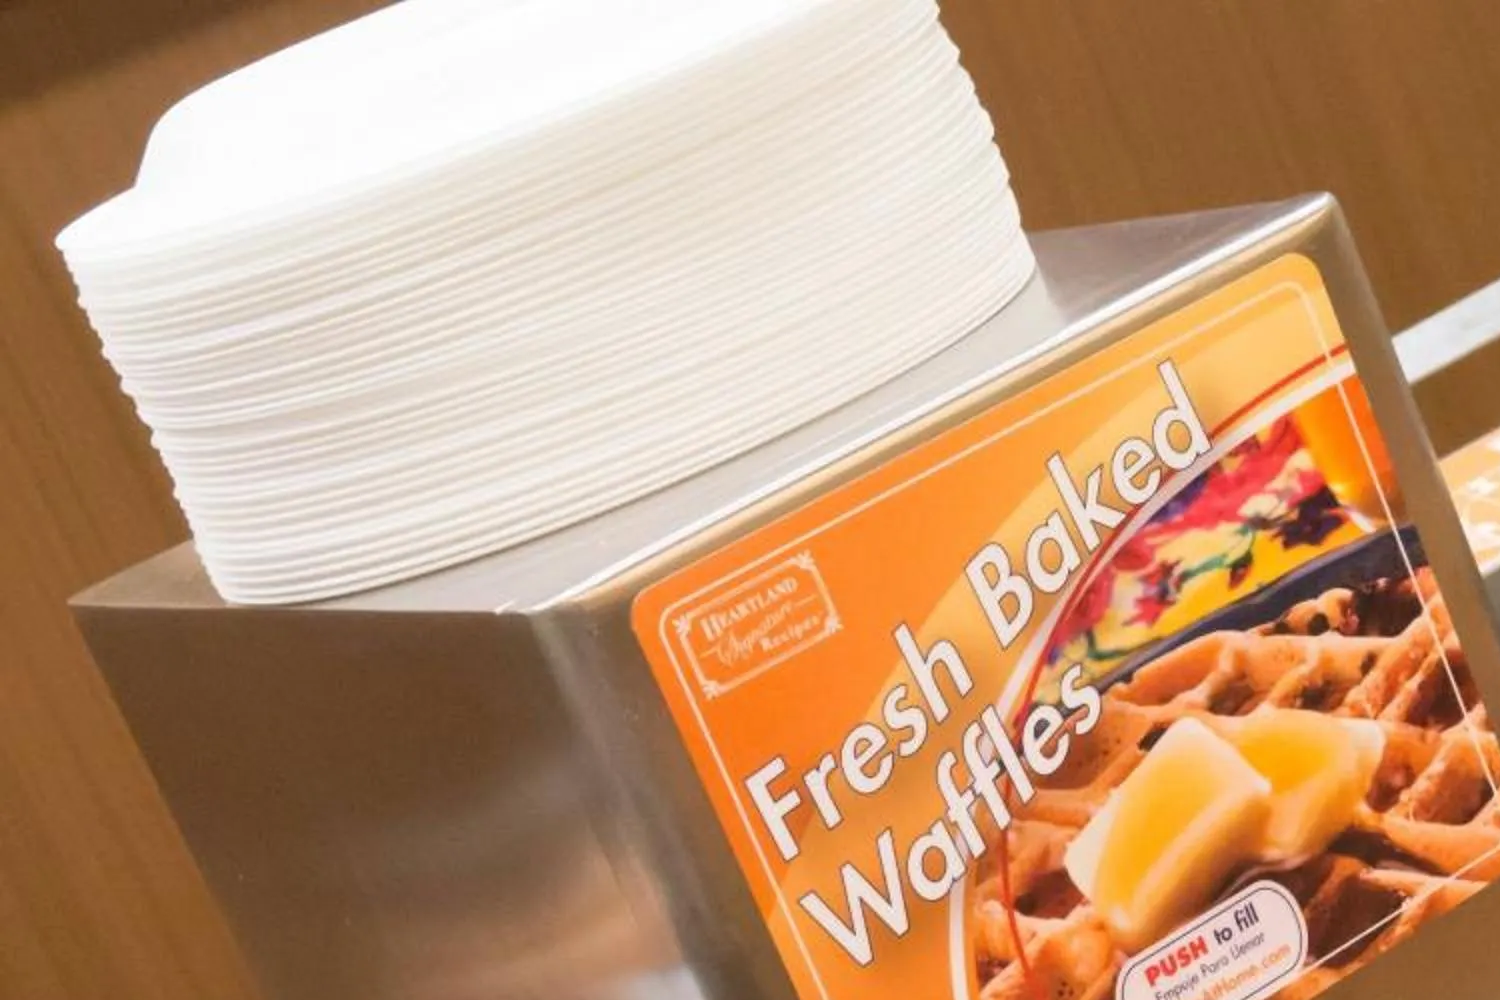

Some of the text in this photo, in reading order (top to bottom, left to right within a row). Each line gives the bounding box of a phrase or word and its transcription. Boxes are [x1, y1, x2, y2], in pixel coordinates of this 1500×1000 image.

[701, 577, 798, 640] HEARTLAND
[745, 357, 1213, 863] Fresh Baked
[798, 663, 1101, 966] Waffles
[1144, 901, 1259, 987] PUSH to fill
[1200, 955, 1230, 978] Para
[1232, 932, 1265, 960] Llenar
